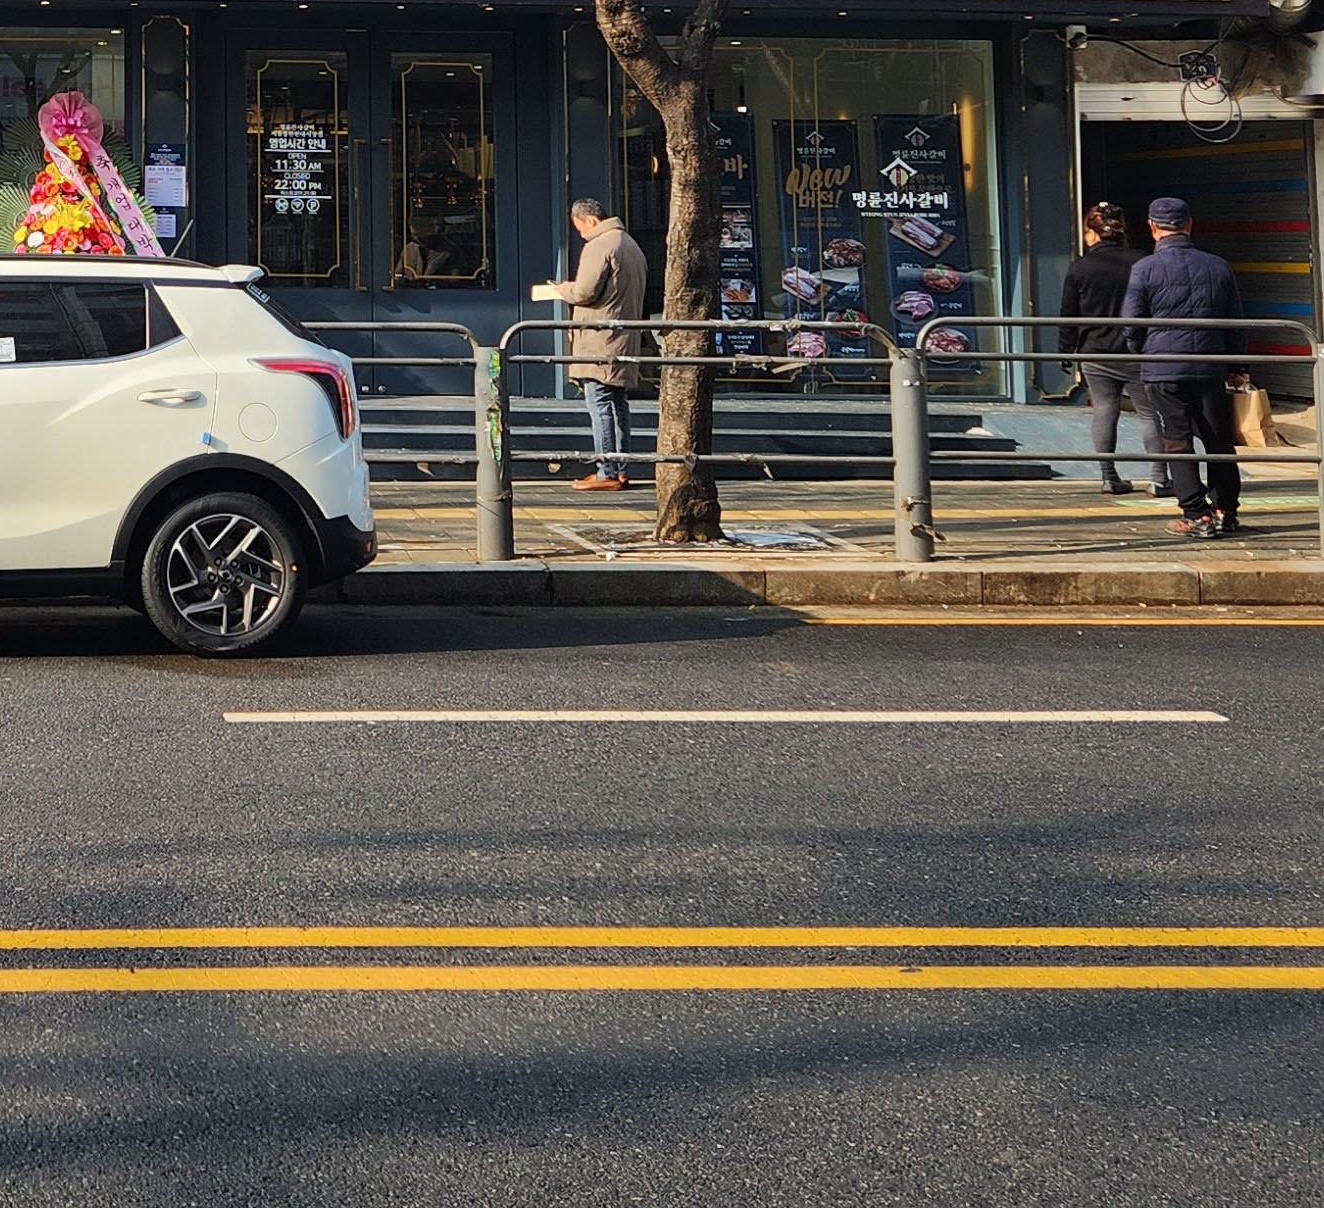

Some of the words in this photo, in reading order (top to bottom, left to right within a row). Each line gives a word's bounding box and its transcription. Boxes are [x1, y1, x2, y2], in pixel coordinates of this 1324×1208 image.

[269, 138, 306, 150] 영업시간
[307, 138, 327, 150] 안내
[275, 159, 307, 170] 11:30
[308, 162, 322, 170] AM
[283, 172, 311, 180] CLOSED
[786, 163, 852, 196] New
[274, 179, 307, 190] 22:00
[309, 182, 322, 190] PM
[852, 191, 948, 210] 명륜진사갈비
